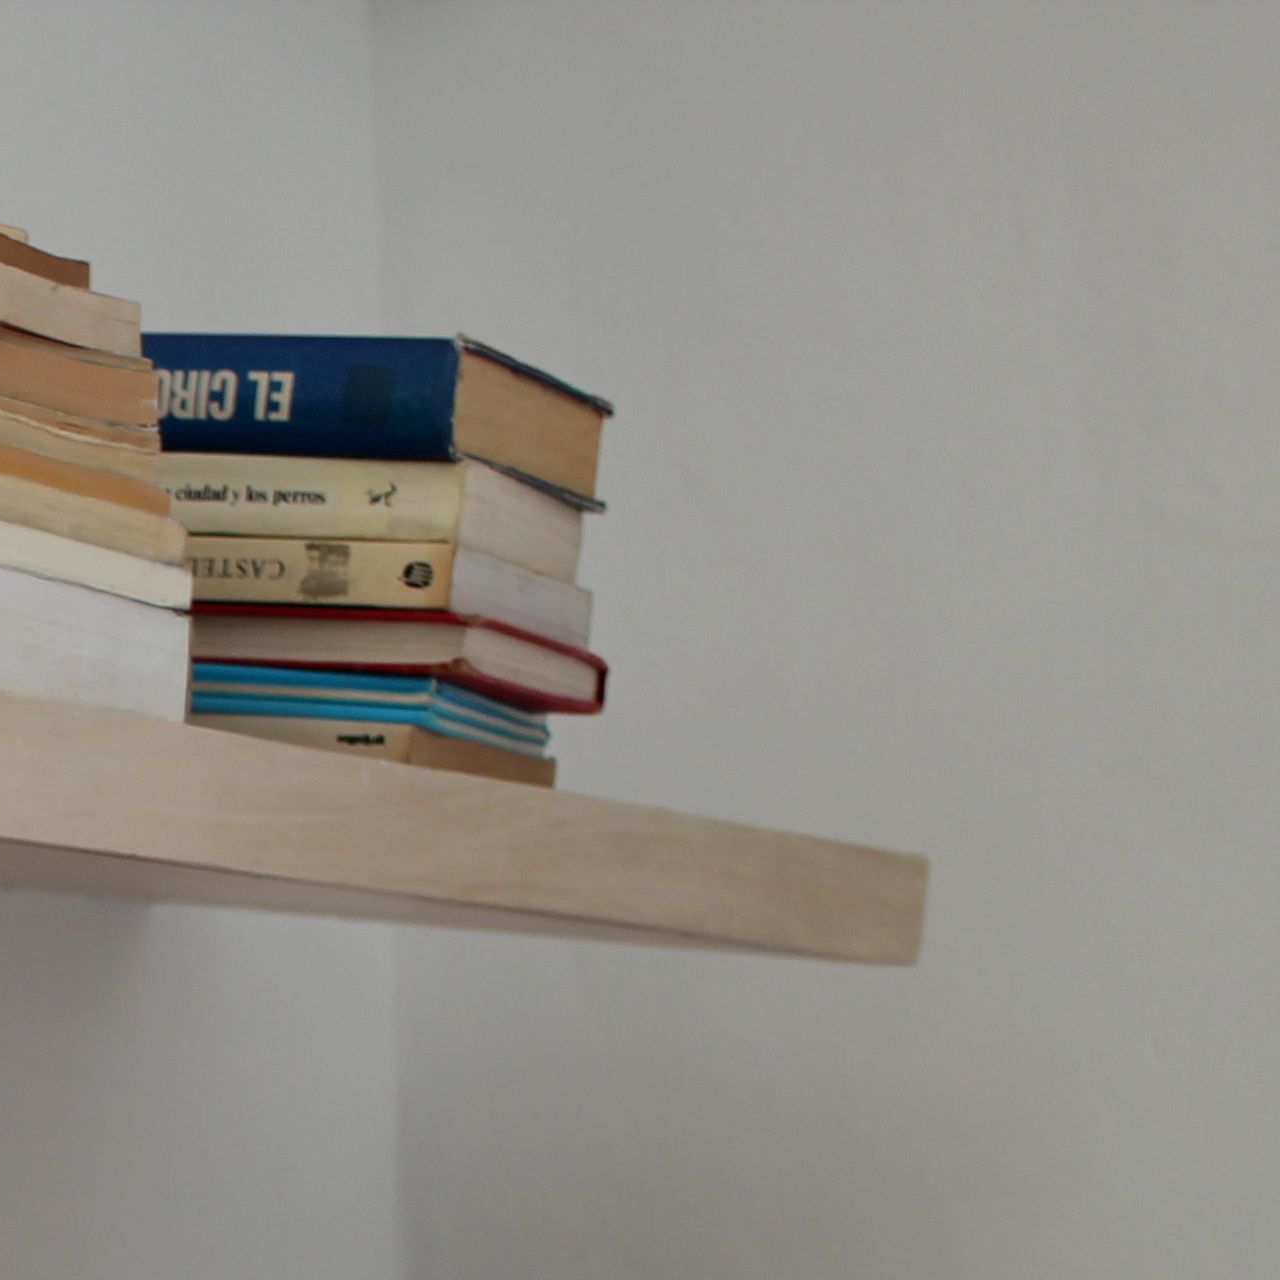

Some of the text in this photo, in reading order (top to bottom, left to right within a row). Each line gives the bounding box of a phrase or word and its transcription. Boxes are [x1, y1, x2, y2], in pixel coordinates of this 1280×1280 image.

[247, 370, 295, 421] EL
[174, 483, 230, 502] ciudad
[231, 490, 240, 506] y
[245, 484, 268, 503] los
[272, 490, 328, 506] perros
